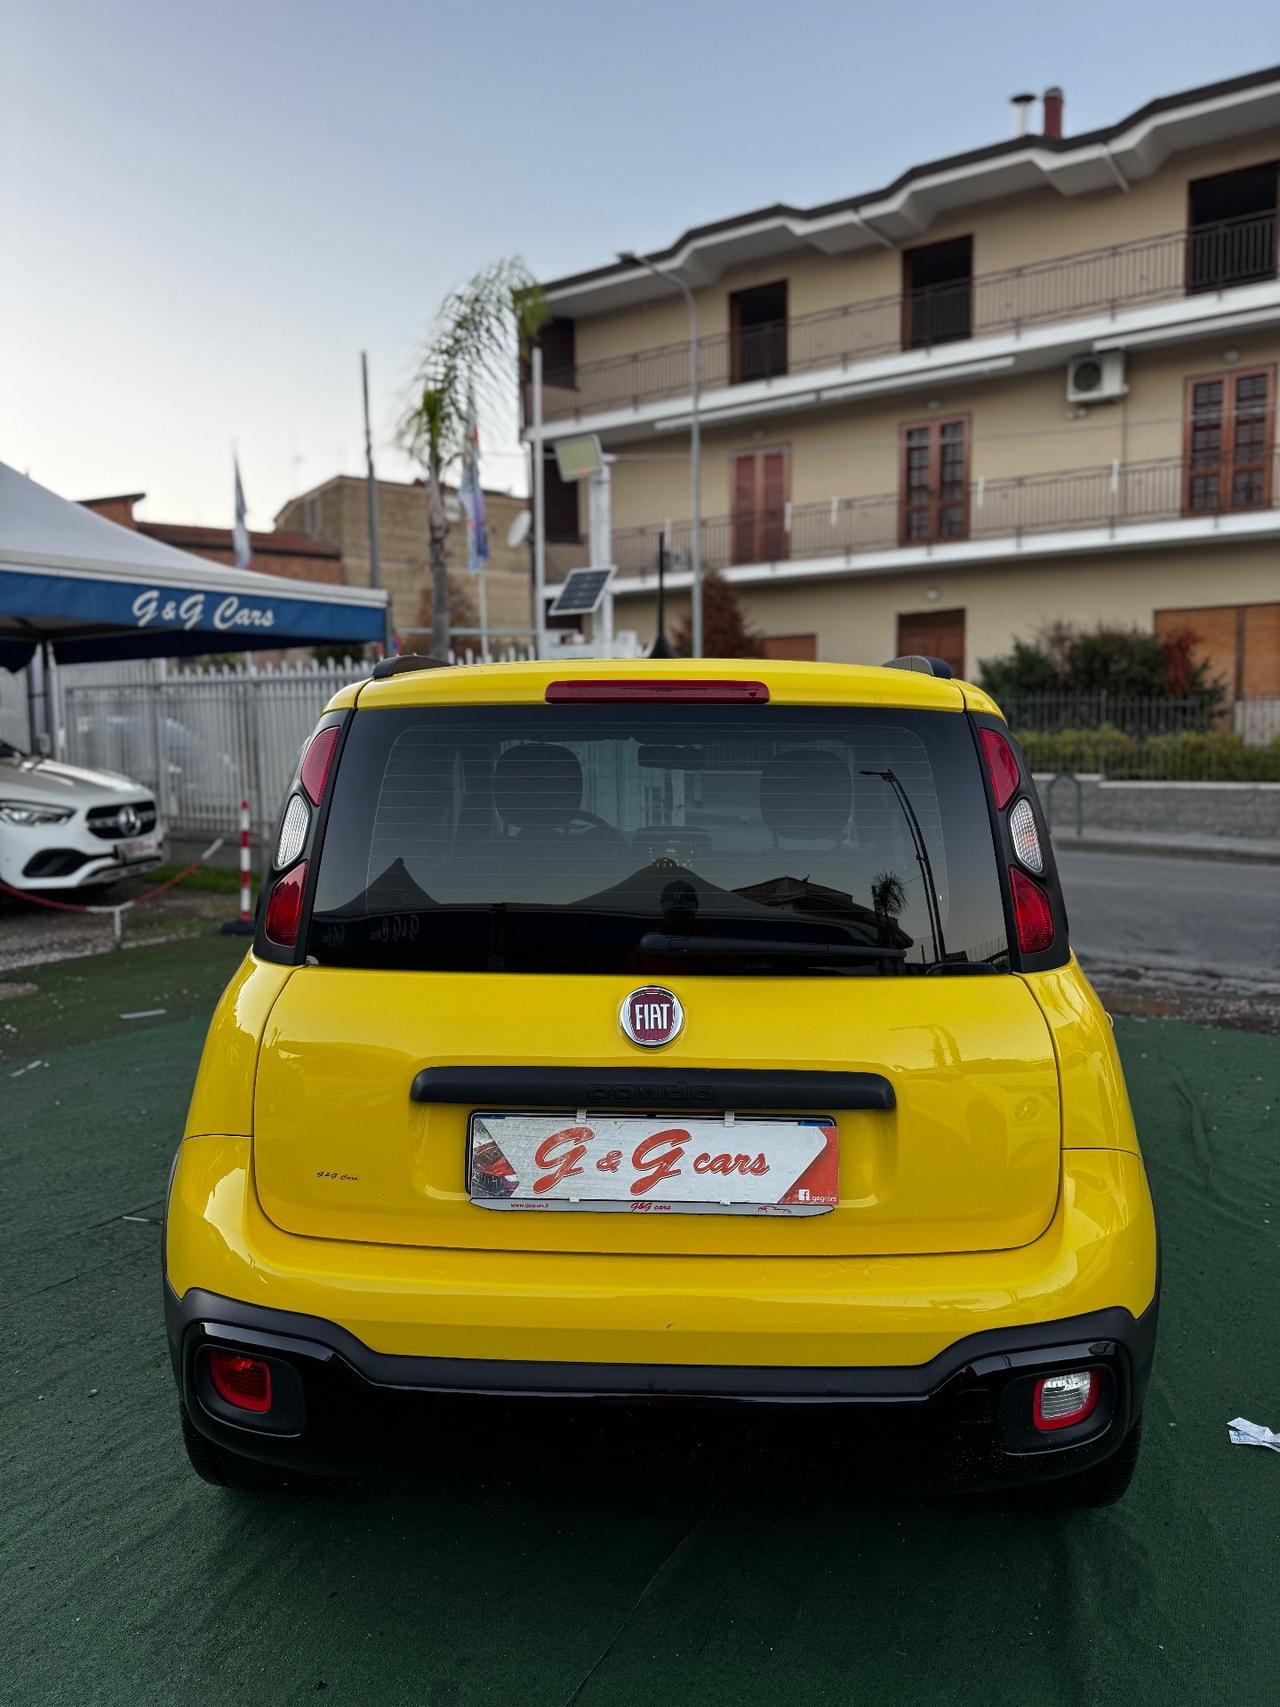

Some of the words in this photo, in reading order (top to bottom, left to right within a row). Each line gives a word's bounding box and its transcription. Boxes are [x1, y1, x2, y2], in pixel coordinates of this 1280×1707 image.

[132, 589, 206, 631] G&G
[213, 596, 275, 630] Cars
[634, 1003, 671, 1030] FIAT
[586, 1081, 717, 1103] panda
[692, 1152, 770, 1177] cars
[654, 1204, 672, 1212] cars
